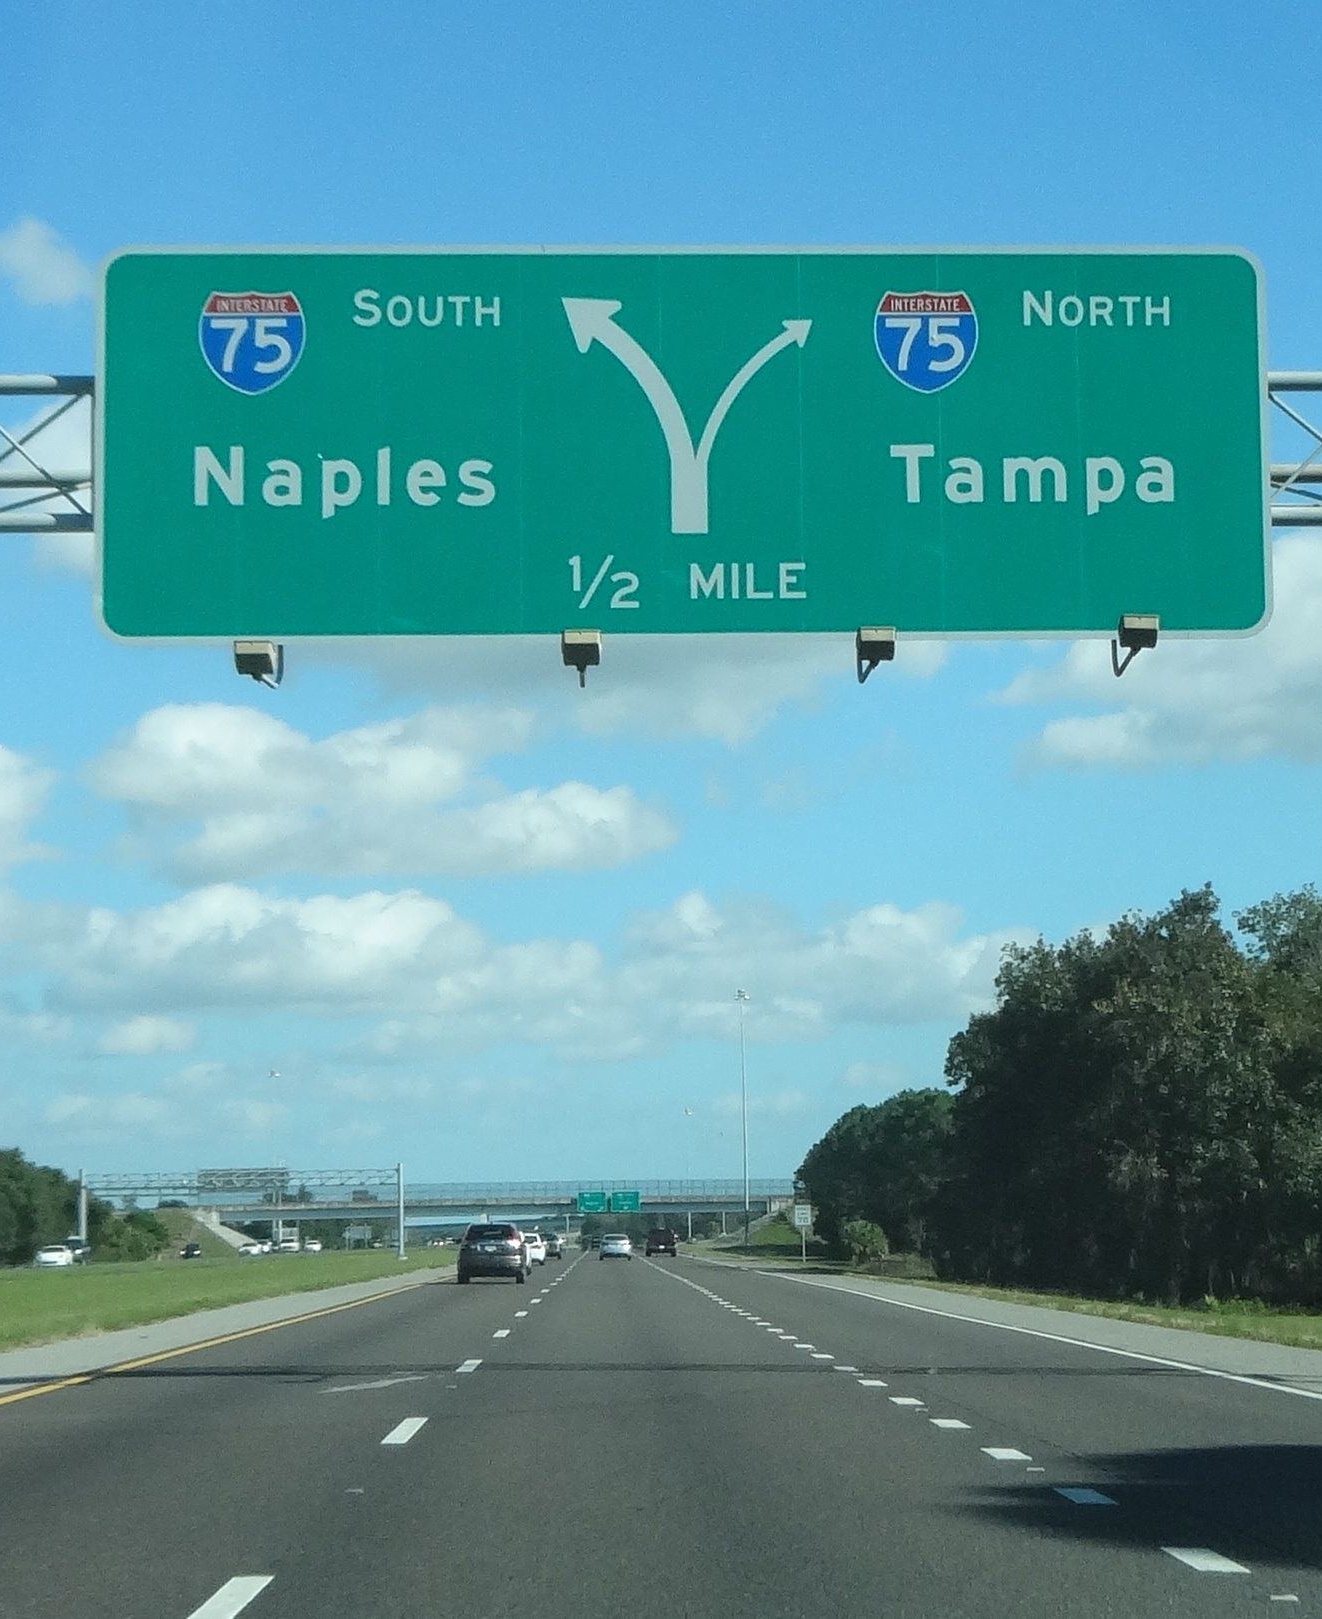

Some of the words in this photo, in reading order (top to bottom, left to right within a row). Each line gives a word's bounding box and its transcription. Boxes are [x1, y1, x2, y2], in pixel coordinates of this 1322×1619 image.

[215, 298, 289, 312] INTERSTATE
[352, 288, 501, 328] SOUTH
[890, 298, 961, 312] INTERSTATE
[1022, 289, 1171, 327] NORTH
[209, 317, 293, 374] 75
[884, 317, 966, 373] 75
[193, 445, 497, 520] Naples
[888, 442, 1176, 517] Tampa
[689, 561, 808, 600] MILE
